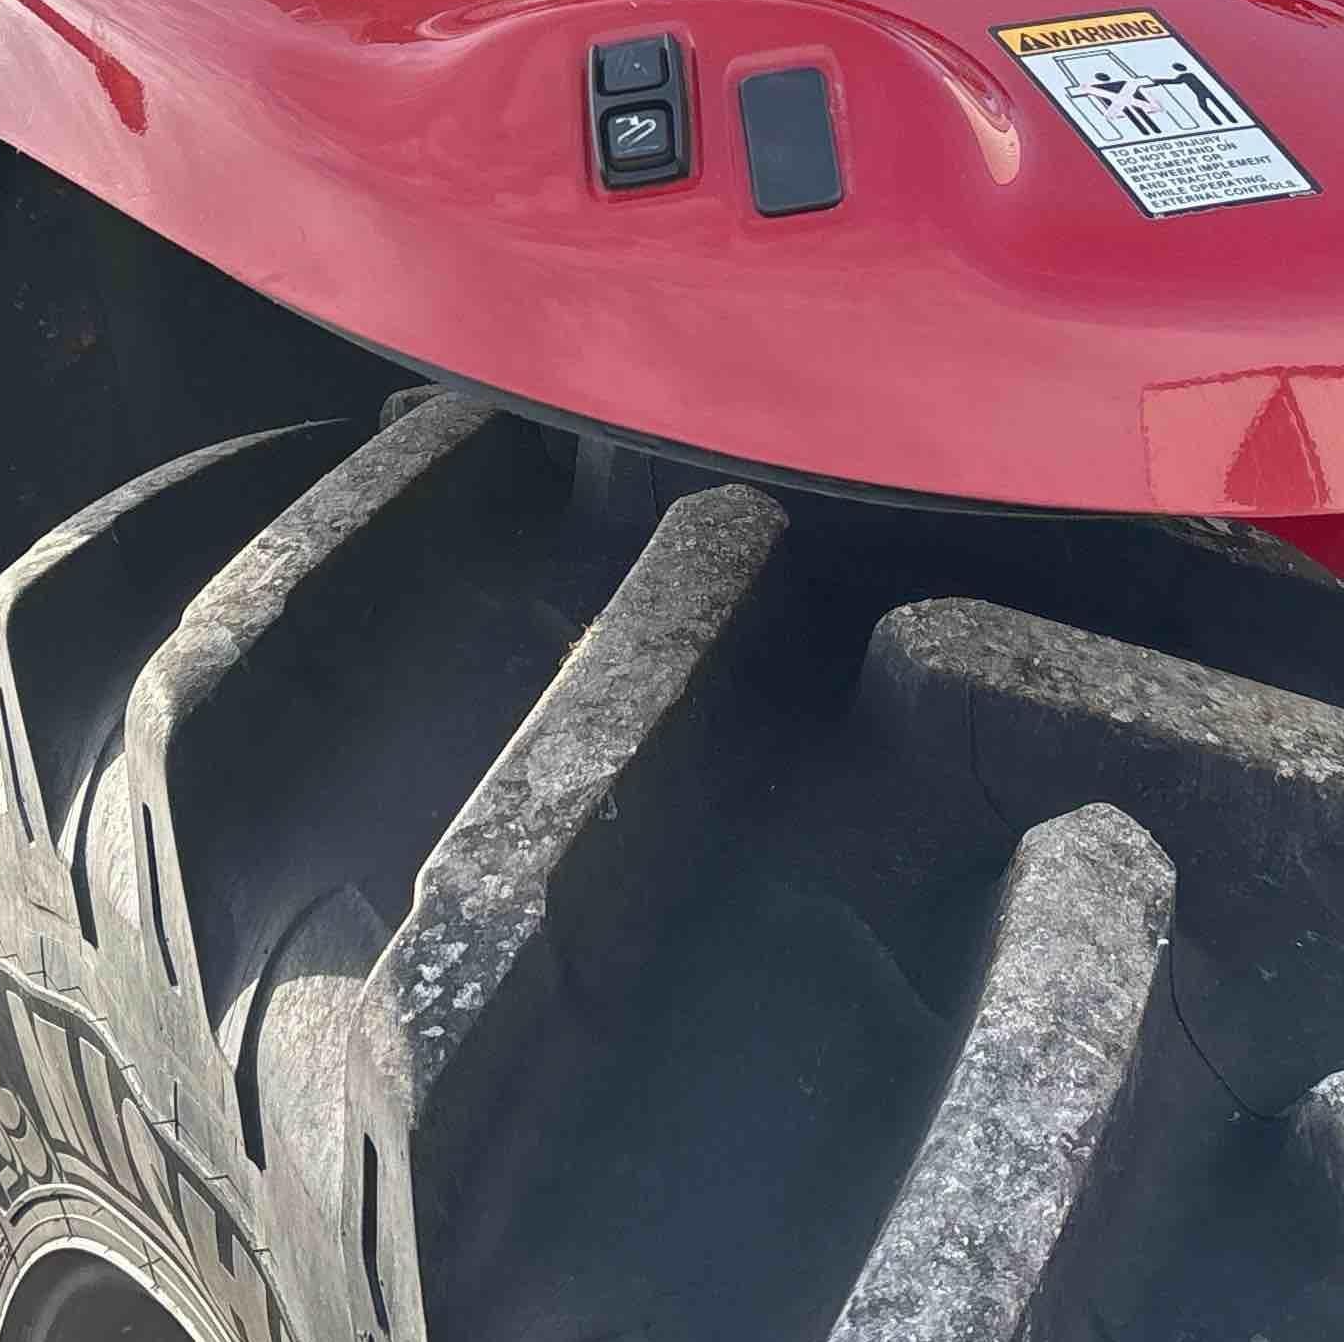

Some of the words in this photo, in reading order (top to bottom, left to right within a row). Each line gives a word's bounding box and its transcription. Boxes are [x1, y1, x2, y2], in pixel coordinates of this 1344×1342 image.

[1041, 19, 1163, 48] WARNING
[1109, 149, 1130, 157] TO
[1133, 142, 1173, 154] AVOID
[1116, 157, 1137, 166] DO
[1139, 152, 1167, 162] NOT
[1169, 145, 1215, 157] STAND
[1216, 141, 1238, 151] ON
[1123, 157, 1198, 174] IMPLEMENT
[1201, 153, 1223, 162] OR
[1131, 166, 1196, 183] BETWEEN
[1197, 155, 1272, 171] IMPLEMENT
[1139, 180, 1167, 191] AND
[1168, 170, 1233, 185] TRACTOR
[1144, 186, 1188, 199] WHILE
[1189, 174, 1267, 192] OPERATING
[1151, 191, 1222, 208] EXTERNAL
